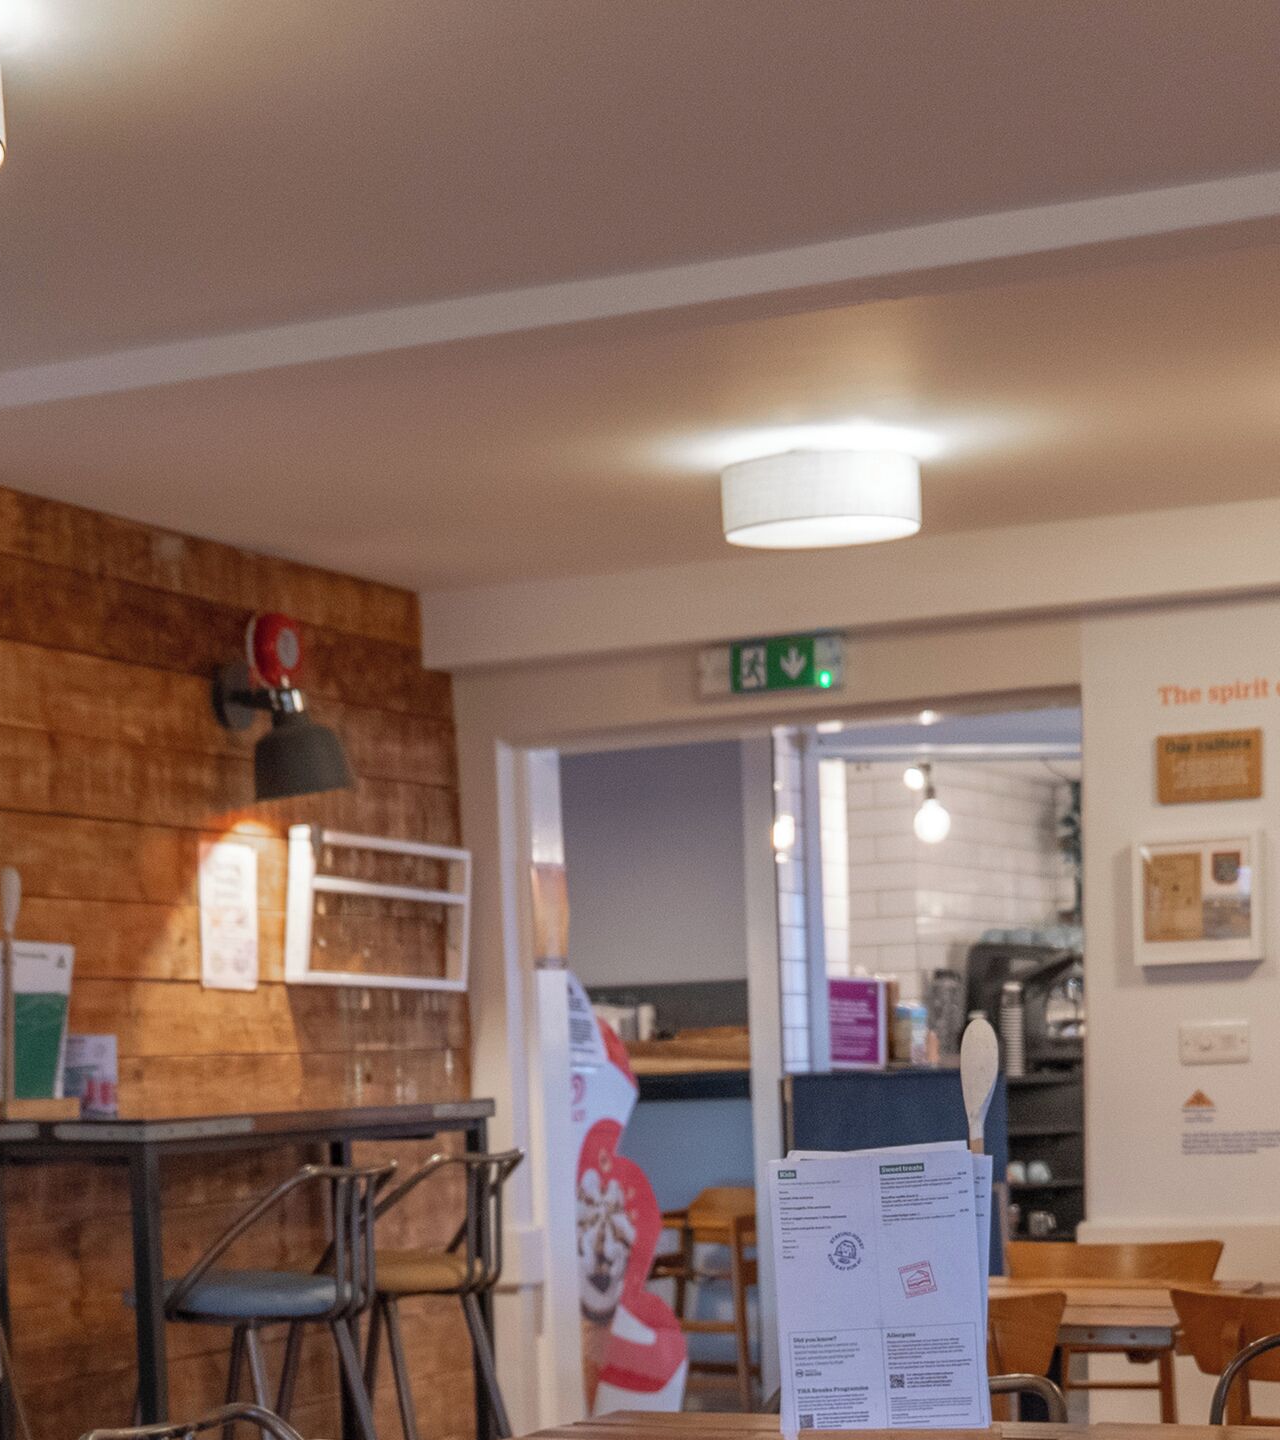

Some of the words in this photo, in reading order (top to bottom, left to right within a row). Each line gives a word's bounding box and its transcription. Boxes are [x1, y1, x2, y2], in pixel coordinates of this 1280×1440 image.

[1158, 682, 1201, 706] The
[1208, 677, 1269, 704] spirit
[881, 1164, 901, 1173] Sweet
[903, 1163, 923, 1172] treats
